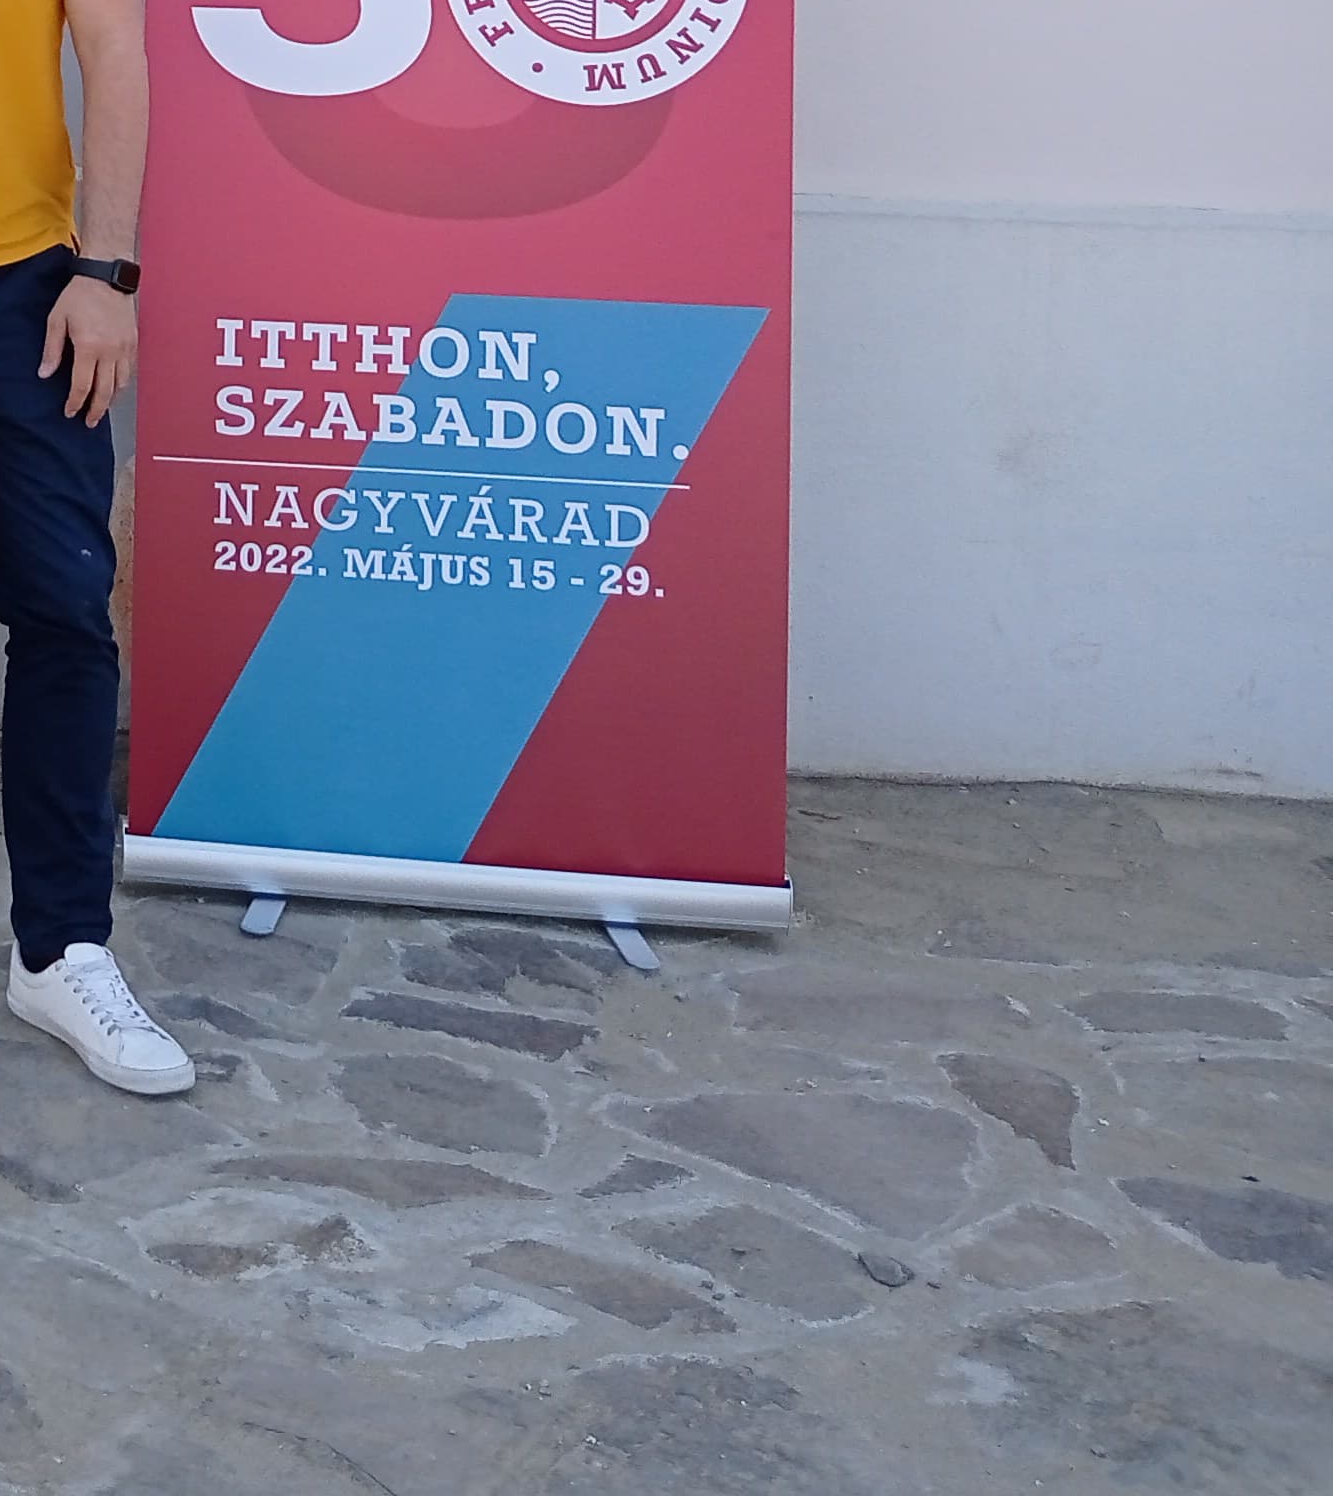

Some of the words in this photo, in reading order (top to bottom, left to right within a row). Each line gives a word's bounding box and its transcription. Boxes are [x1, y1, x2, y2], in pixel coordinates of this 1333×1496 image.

[215, 317, 561, 393] ITTHON,
[214, 385, 691, 461] SZABADON.
[213, 481, 651, 549] NAGYVÁRAD
[213, 540, 328, 578] 2022.
[343, 543, 492, 591] MÁJUS
[508, 557, 557, 591] 15
[598, 563, 665, 598] 29.
